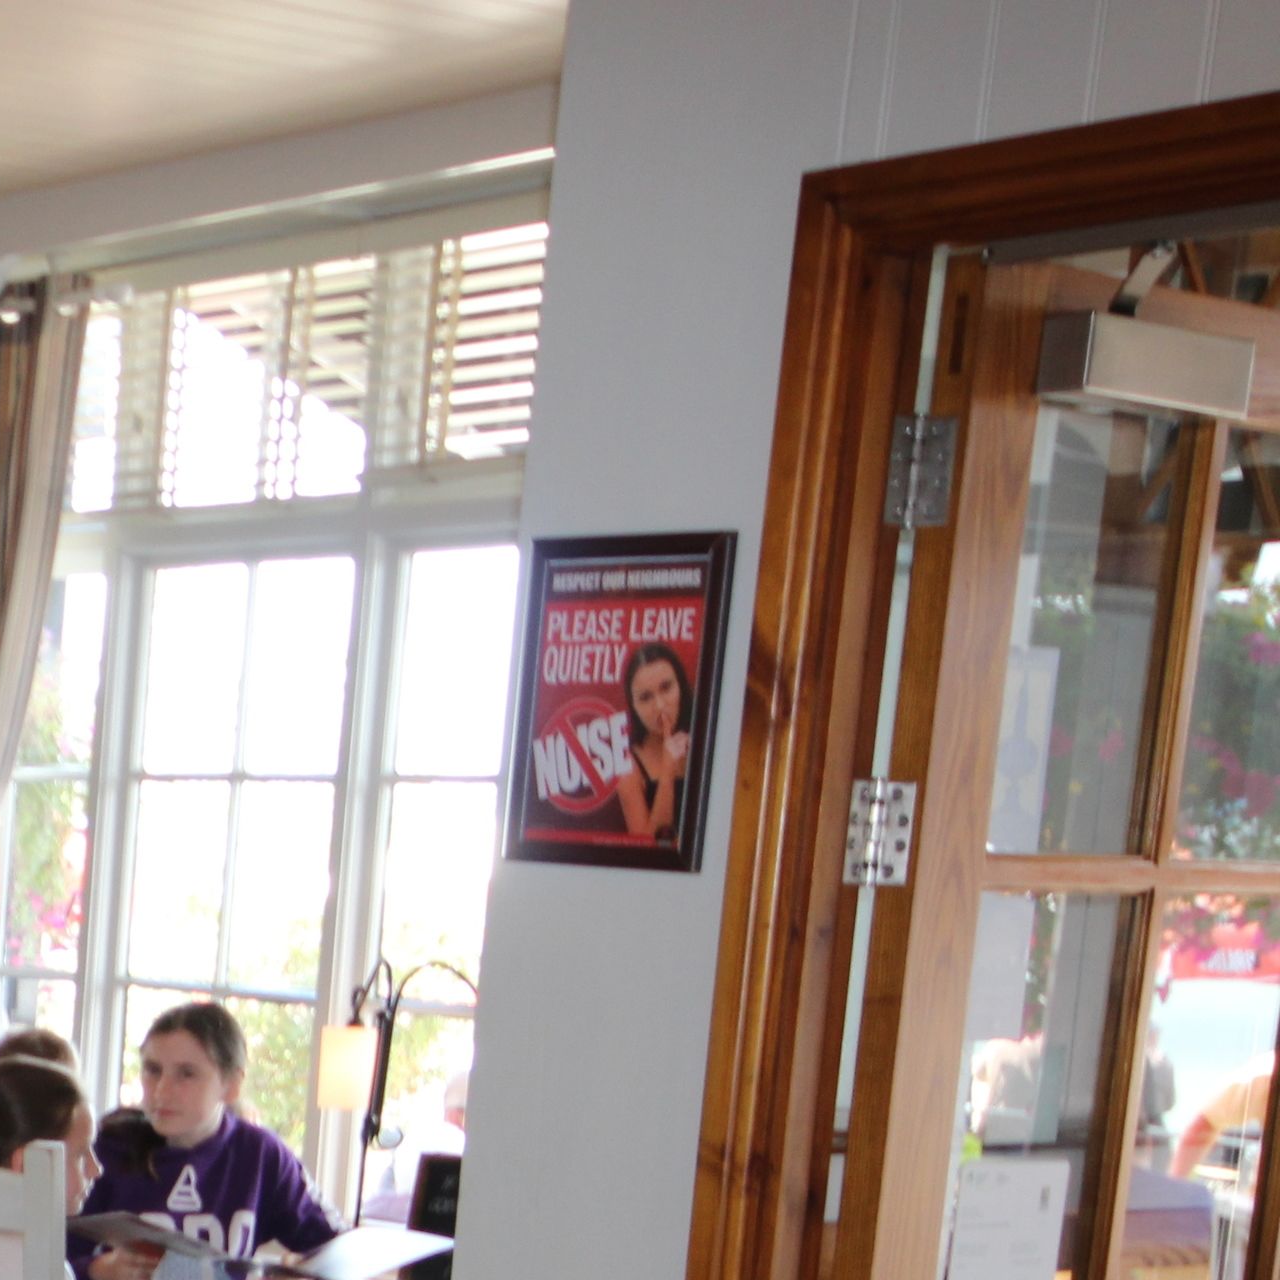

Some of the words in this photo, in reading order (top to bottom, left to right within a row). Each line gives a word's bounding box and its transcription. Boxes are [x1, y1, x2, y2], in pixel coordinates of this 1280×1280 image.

[552, 571, 602, 592] RESPECT
[601, 570, 626, 591] OUR
[626, 568, 702, 591] NEIGHBOURS
[546, 608, 625, 642] PLEASE
[628, 606, 696, 641] LEAVE
[543, 643, 627, 685] QUIETLY
[533, 711, 633, 800] NOISE
